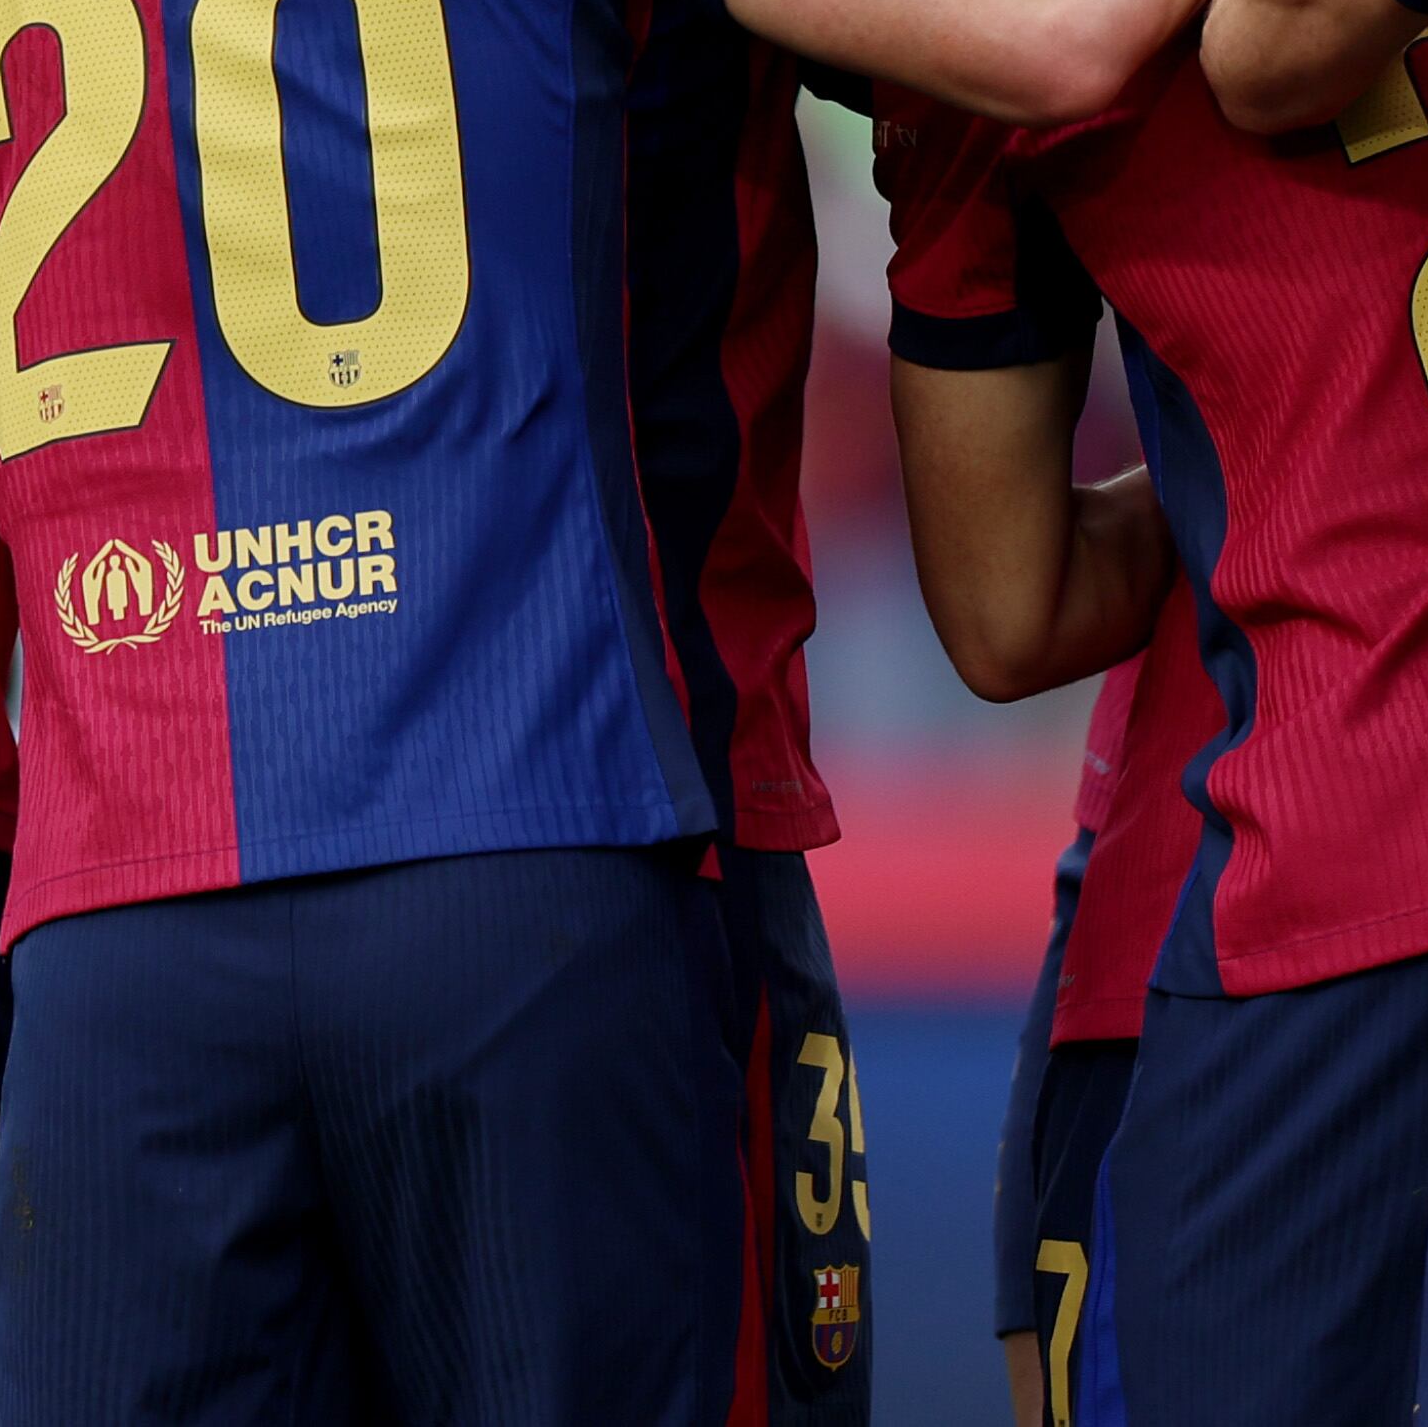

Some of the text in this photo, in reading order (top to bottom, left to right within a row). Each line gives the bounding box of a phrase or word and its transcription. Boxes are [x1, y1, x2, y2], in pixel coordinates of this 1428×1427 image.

[193, 509, 396, 573] UNHCR
[197, 554, 398, 617] ACNUR
[199, 598, 398, 635] The UN Refugee Agency
[1036, 1239, 1088, 1427] 7
